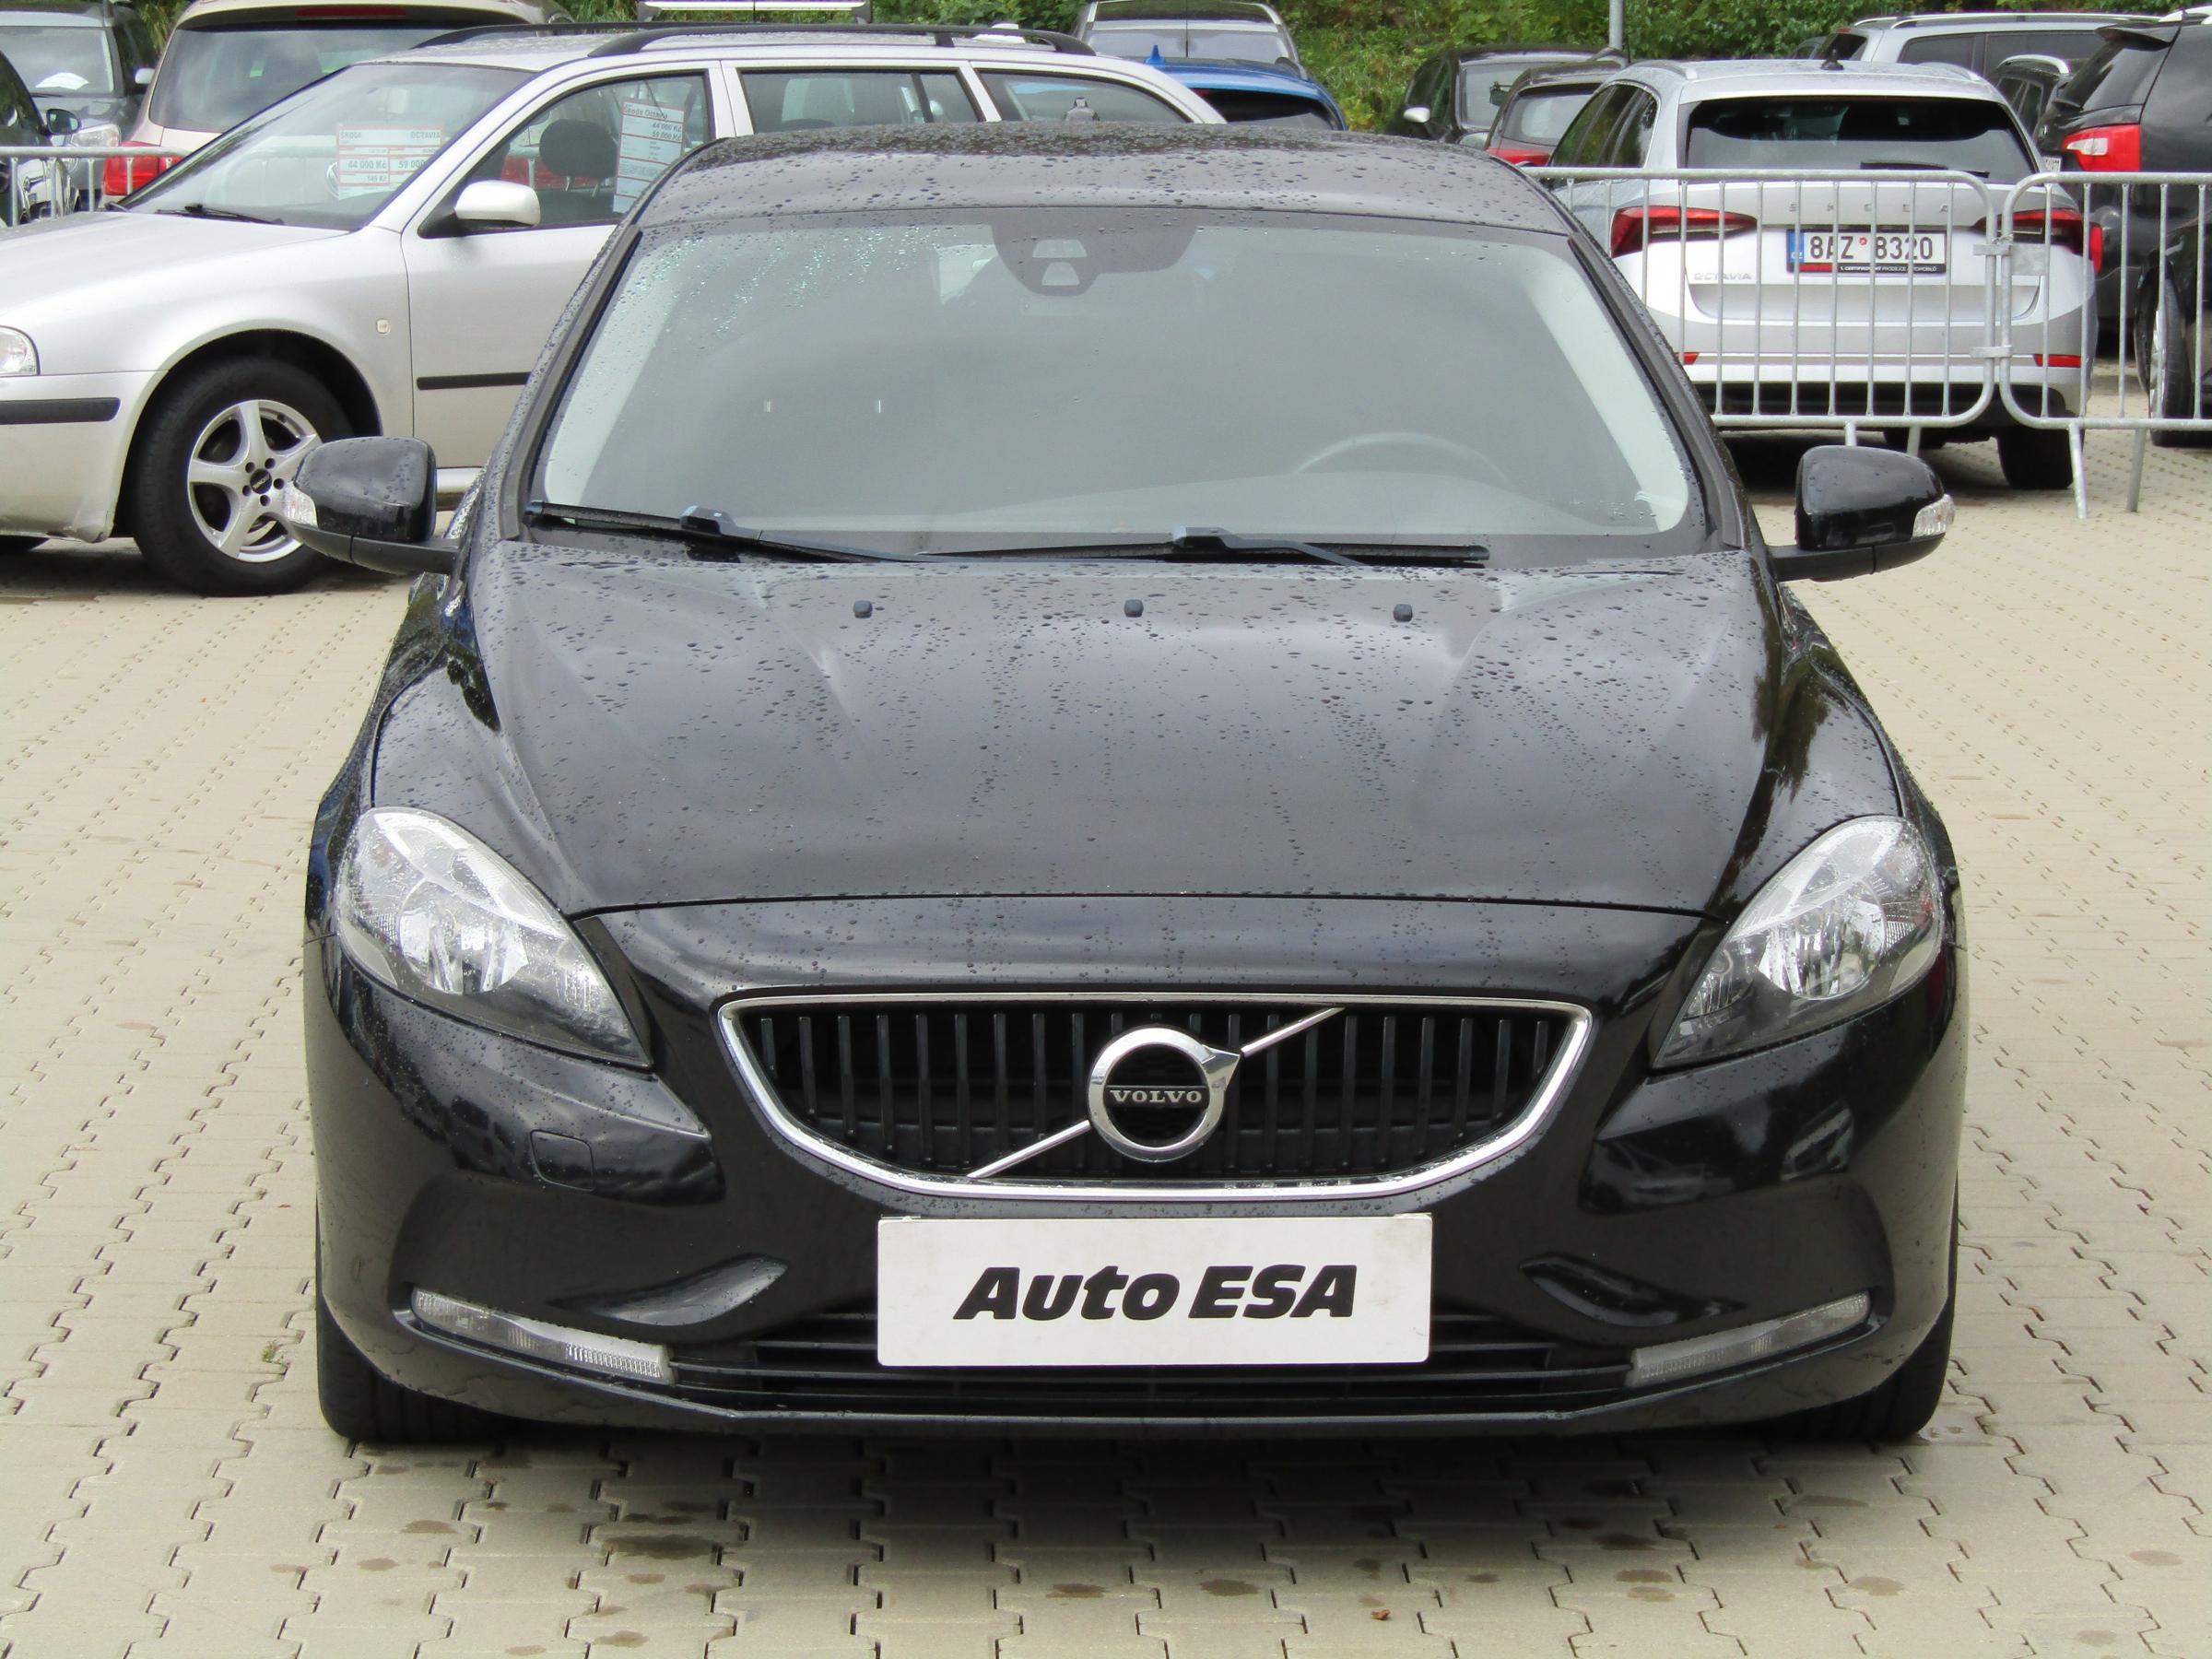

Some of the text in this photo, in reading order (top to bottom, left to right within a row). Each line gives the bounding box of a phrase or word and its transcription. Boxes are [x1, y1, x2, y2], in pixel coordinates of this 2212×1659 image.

[410, 131, 441, 139] OCTAVIA
[359, 159, 373, 169] 000
[398, 159, 408, 169] 59
[1875, 236, 1933, 260] 8320
[1110, 1088, 1203, 1105] VOLVO
[952, 1265, 1358, 1322] Auto ESA
